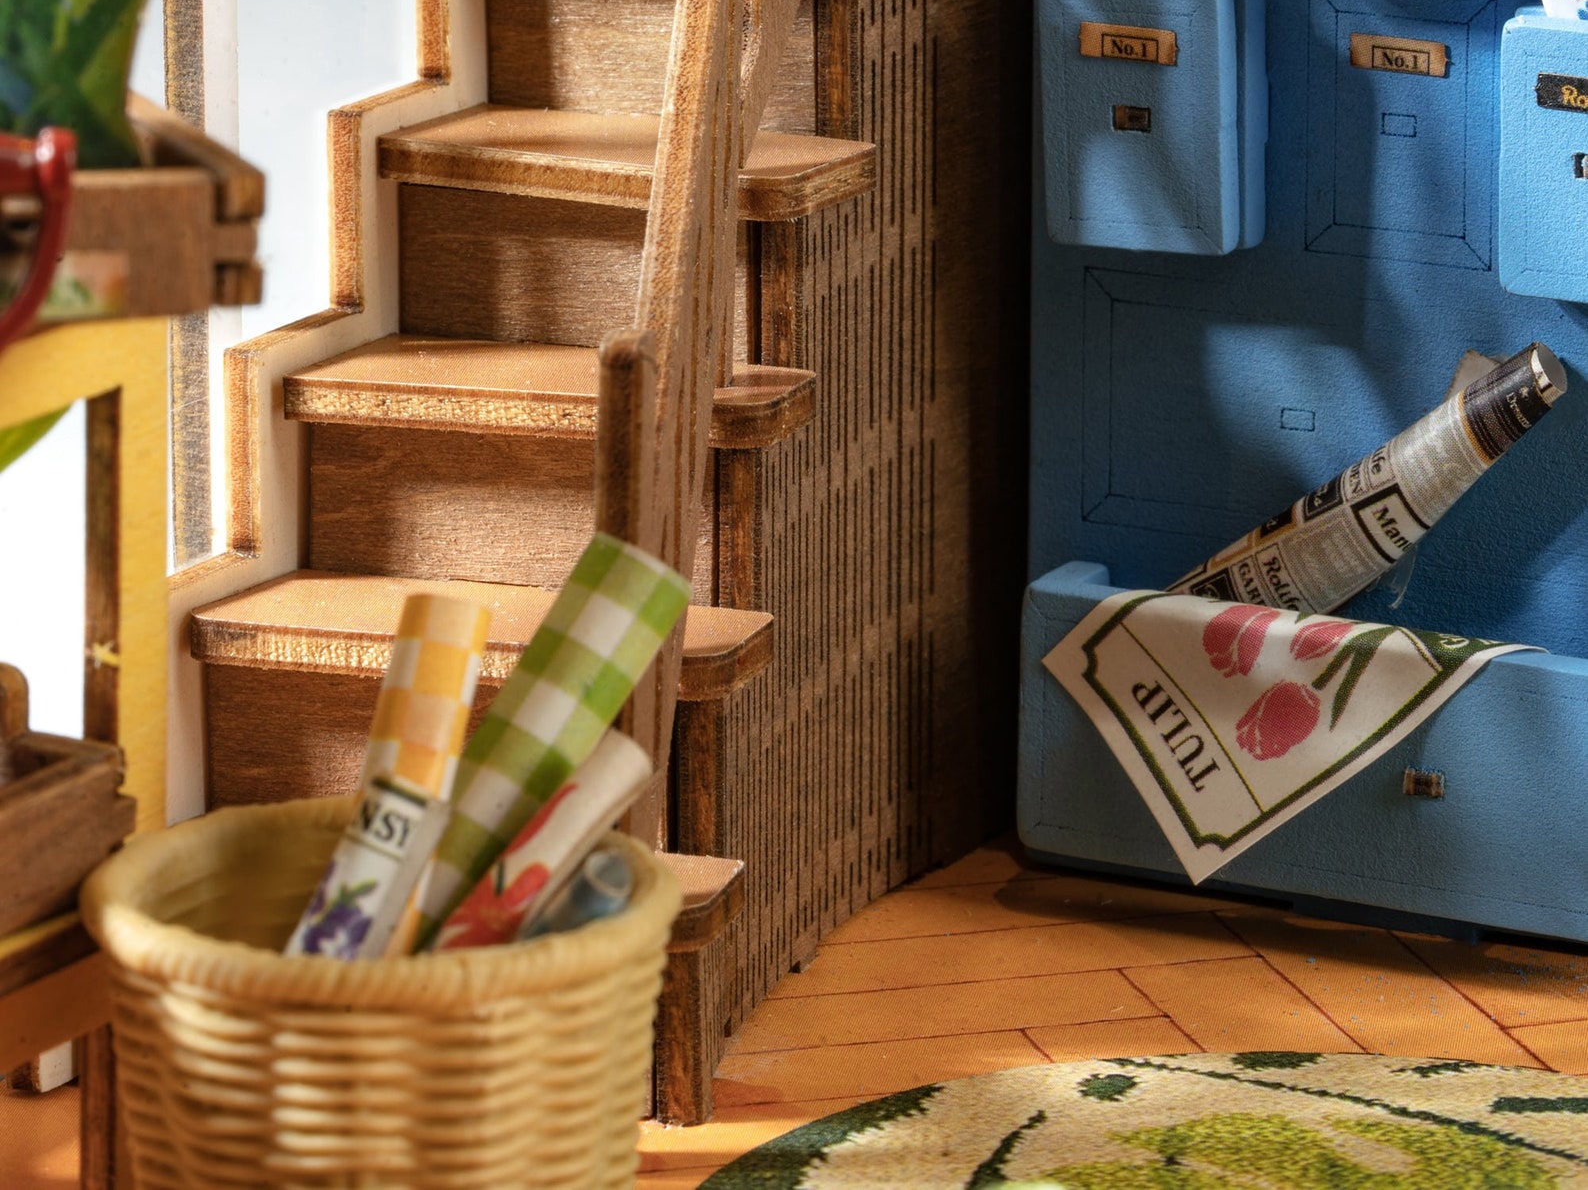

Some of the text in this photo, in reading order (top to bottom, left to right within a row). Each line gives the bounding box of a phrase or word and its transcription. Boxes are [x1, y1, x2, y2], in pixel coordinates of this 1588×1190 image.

[1111, 39, 1147, 58] No.1
[1382, 51, 1419, 70] No.1
[1131, 680, 1221, 792] TULIP
